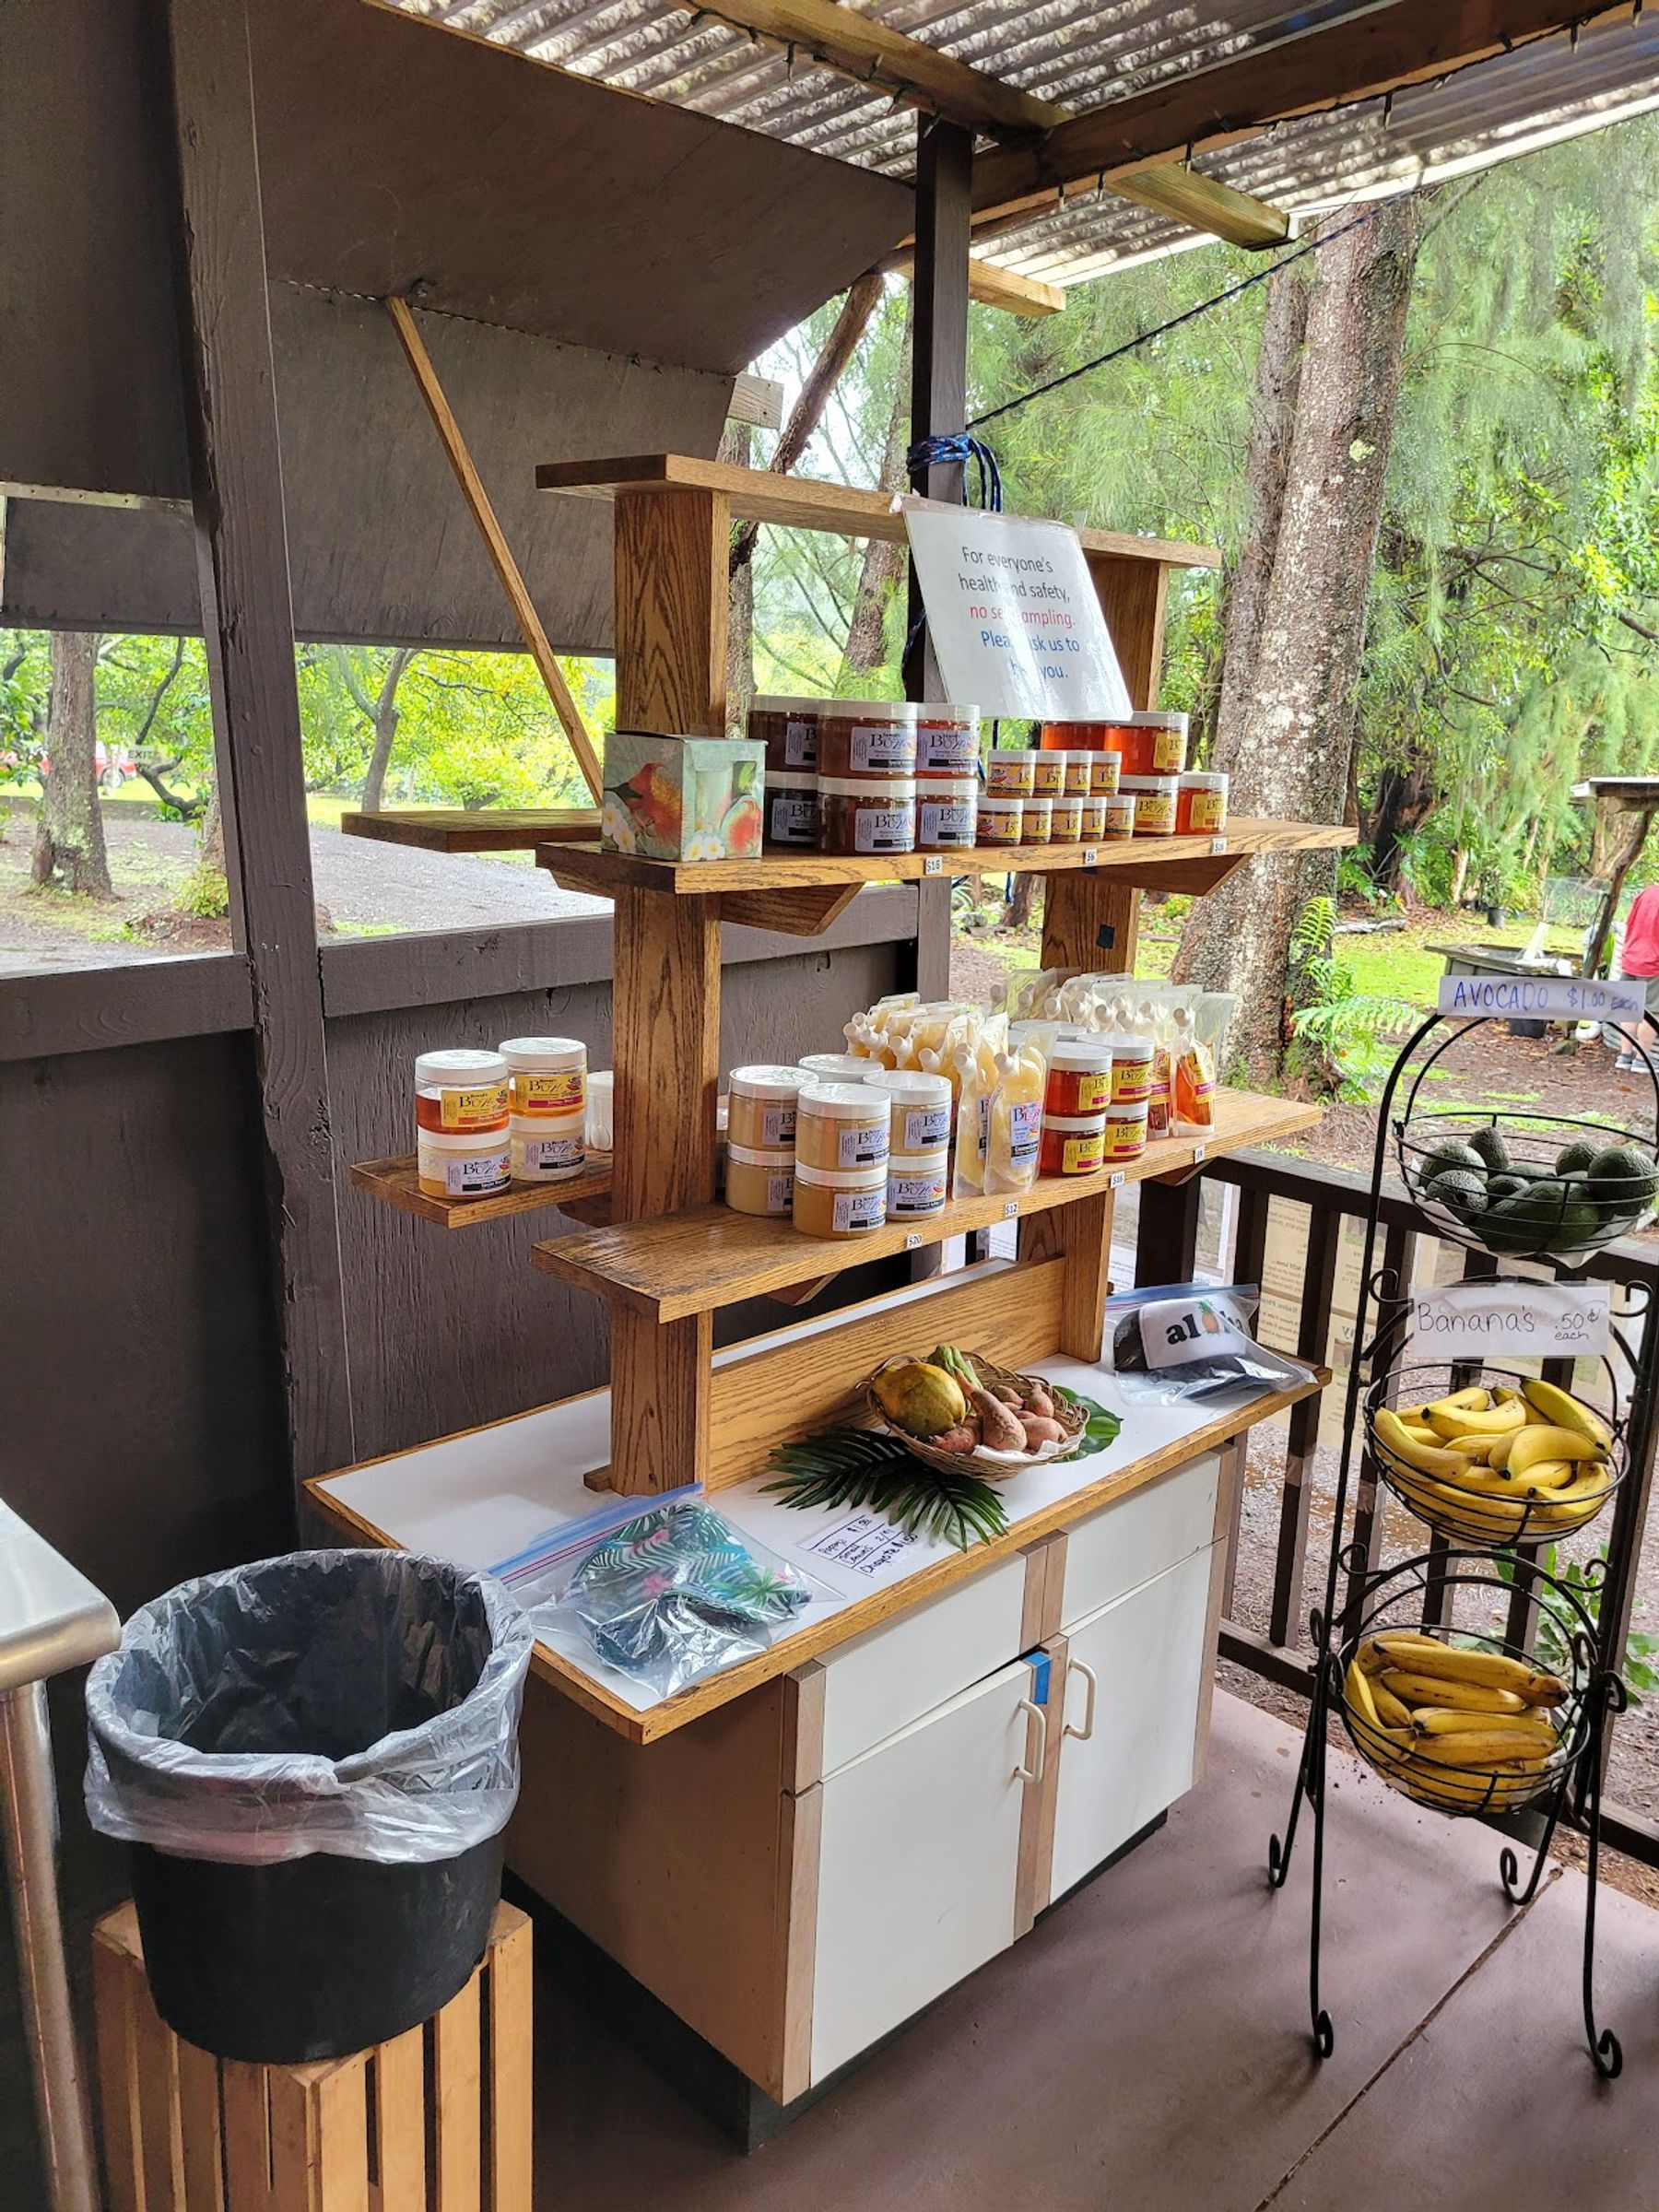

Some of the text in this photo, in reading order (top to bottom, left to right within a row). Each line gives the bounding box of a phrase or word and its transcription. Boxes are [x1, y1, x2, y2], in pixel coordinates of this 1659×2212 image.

[961, 546, 1053, 573] For everyone's
[1030, 582, 1070, 604] safety,
[971, 605, 987, 618] no
[1021, 608, 1076, 629] ampling.
[981, 629, 1011, 647] Plea
[1049, 640, 1064, 651] us
[1065, 638, 1080, 652] to
[1453, 980, 1548, 1012] AVOCADO
[1566, 985, 1606, 1010] $1.00
[1417, 1301, 1535, 1334] Banana's
[1554, 1330, 1591, 1342] each
